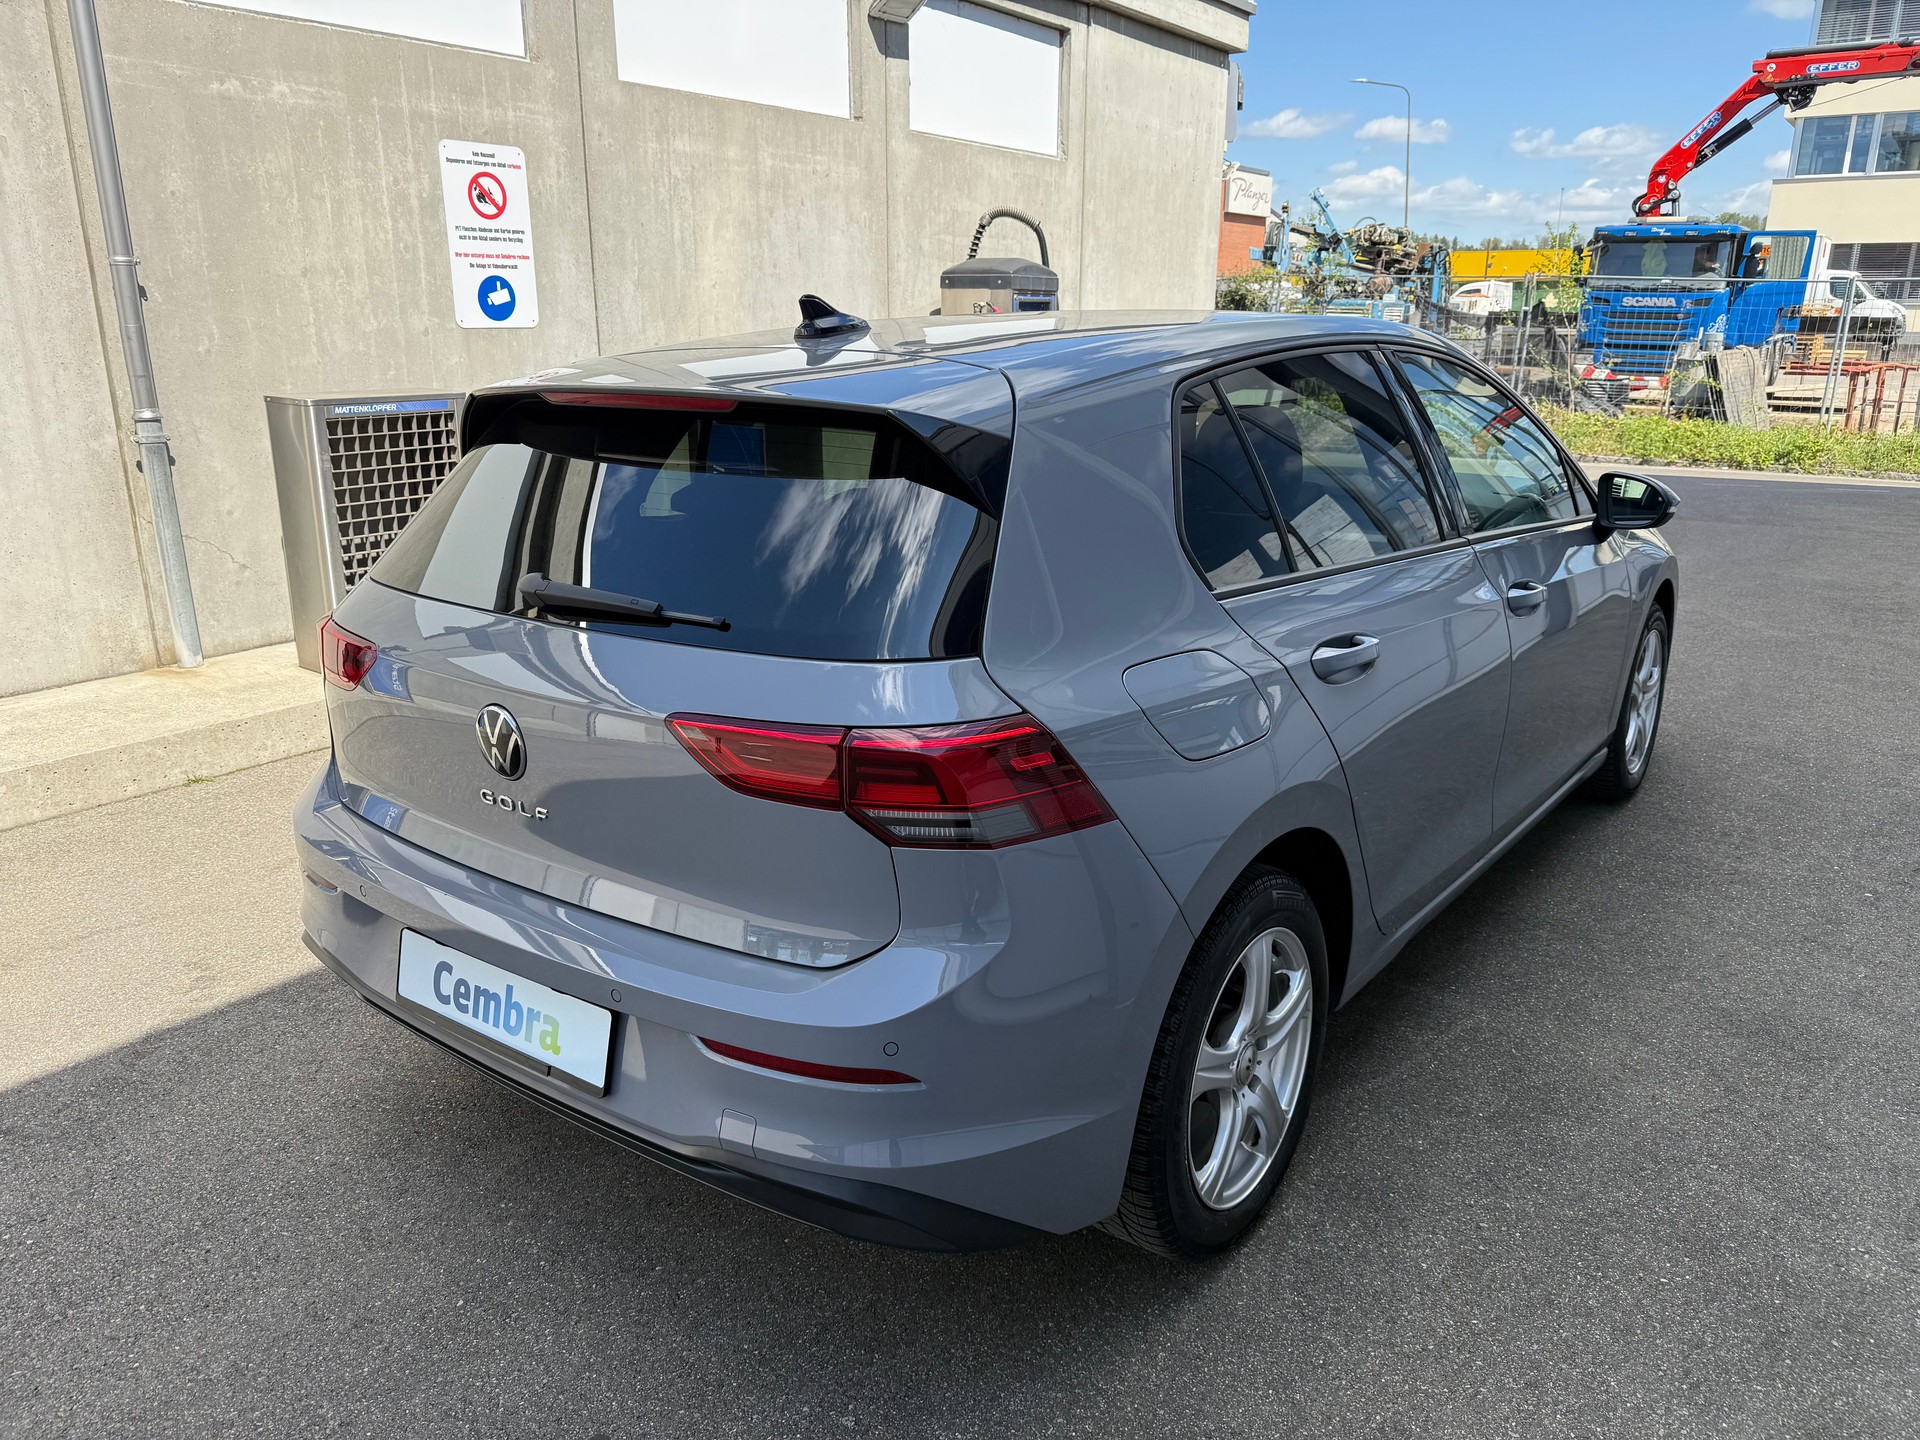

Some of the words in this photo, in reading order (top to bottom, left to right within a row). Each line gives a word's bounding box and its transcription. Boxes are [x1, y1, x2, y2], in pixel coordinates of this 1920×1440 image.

[1808, 61, 1858, 72] EFFER
[1682, 112, 1721, 148] EFFER
[1232, 177, 1270, 210] Planzer
[1621, 296, 1677, 307] SCANIA
[480, 788, 549, 819] GOLF
[433, 960, 561, 1056] Cembra
